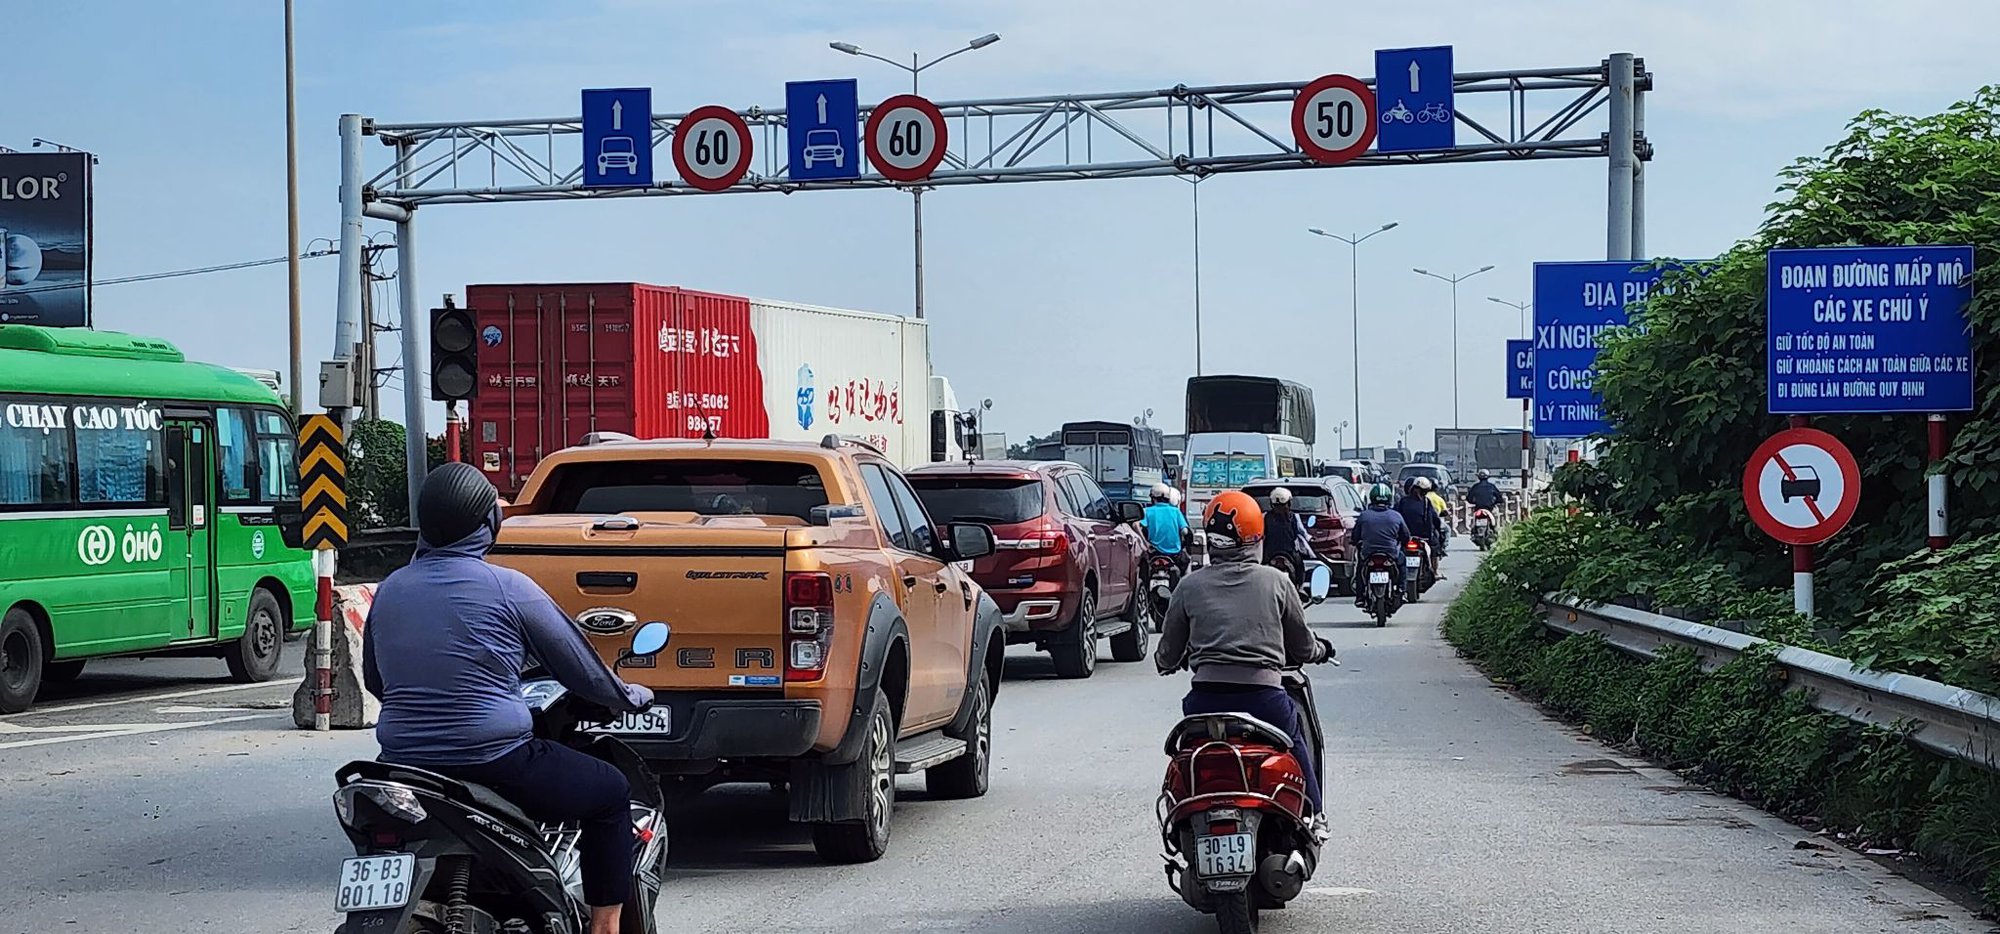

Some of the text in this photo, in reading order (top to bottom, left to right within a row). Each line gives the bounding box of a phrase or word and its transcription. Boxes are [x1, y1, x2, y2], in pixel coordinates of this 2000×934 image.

[1317, 101, 1354, 138] 50
[695, 129, 729, 165] 60
[889, 120, 921, 156] 60
[1781, 265, 1827, 292] ĐOẠN
[1832, 258, 1889, 288] ĐƯỜNG
[1894, 256, 1932, 286] MẤP
[1583, 282, 1617, 311] ĐỊA
[1813, 293, 1929, 322] CÁC XE CHÚ Ý
[1537, 319, 1559, 349] XÍ
[1796, 331, 1814, 350] TỐC
[1832, 335, 1846, 350] AN
[1849, 331, 1875, 350] TOÀN
[1796, 353, 1835, 374] KHOẢNG
[1837, 355, 1863, 374] CÁCH
[1865, 357, 1879, 373] AN
[1881, 354, 1907, 373] TOÀN
[1934, 353, 1953, 372] CÁC
[1956, 357, 1969, 372] XE
[1778, 378, 1925, 400] ĐI ĐÚNG LÀN ĐƯỜNG QUY ĐỊNH
[6, 400, 163, 435] CHẠY CAO TỐC
[1539, 400, 1599, 421] LÝ TRÌNH
[122, 523, 162, 563] ÔHÔ
[592, 615, 617, 626] Ford
[1203, 835, 1246, 855] 30-L9
[350, 858, 403, 882] 36-B3
[1206, 855, 1247, 875] 1634
[340, 882, 404, 907] 801.18
